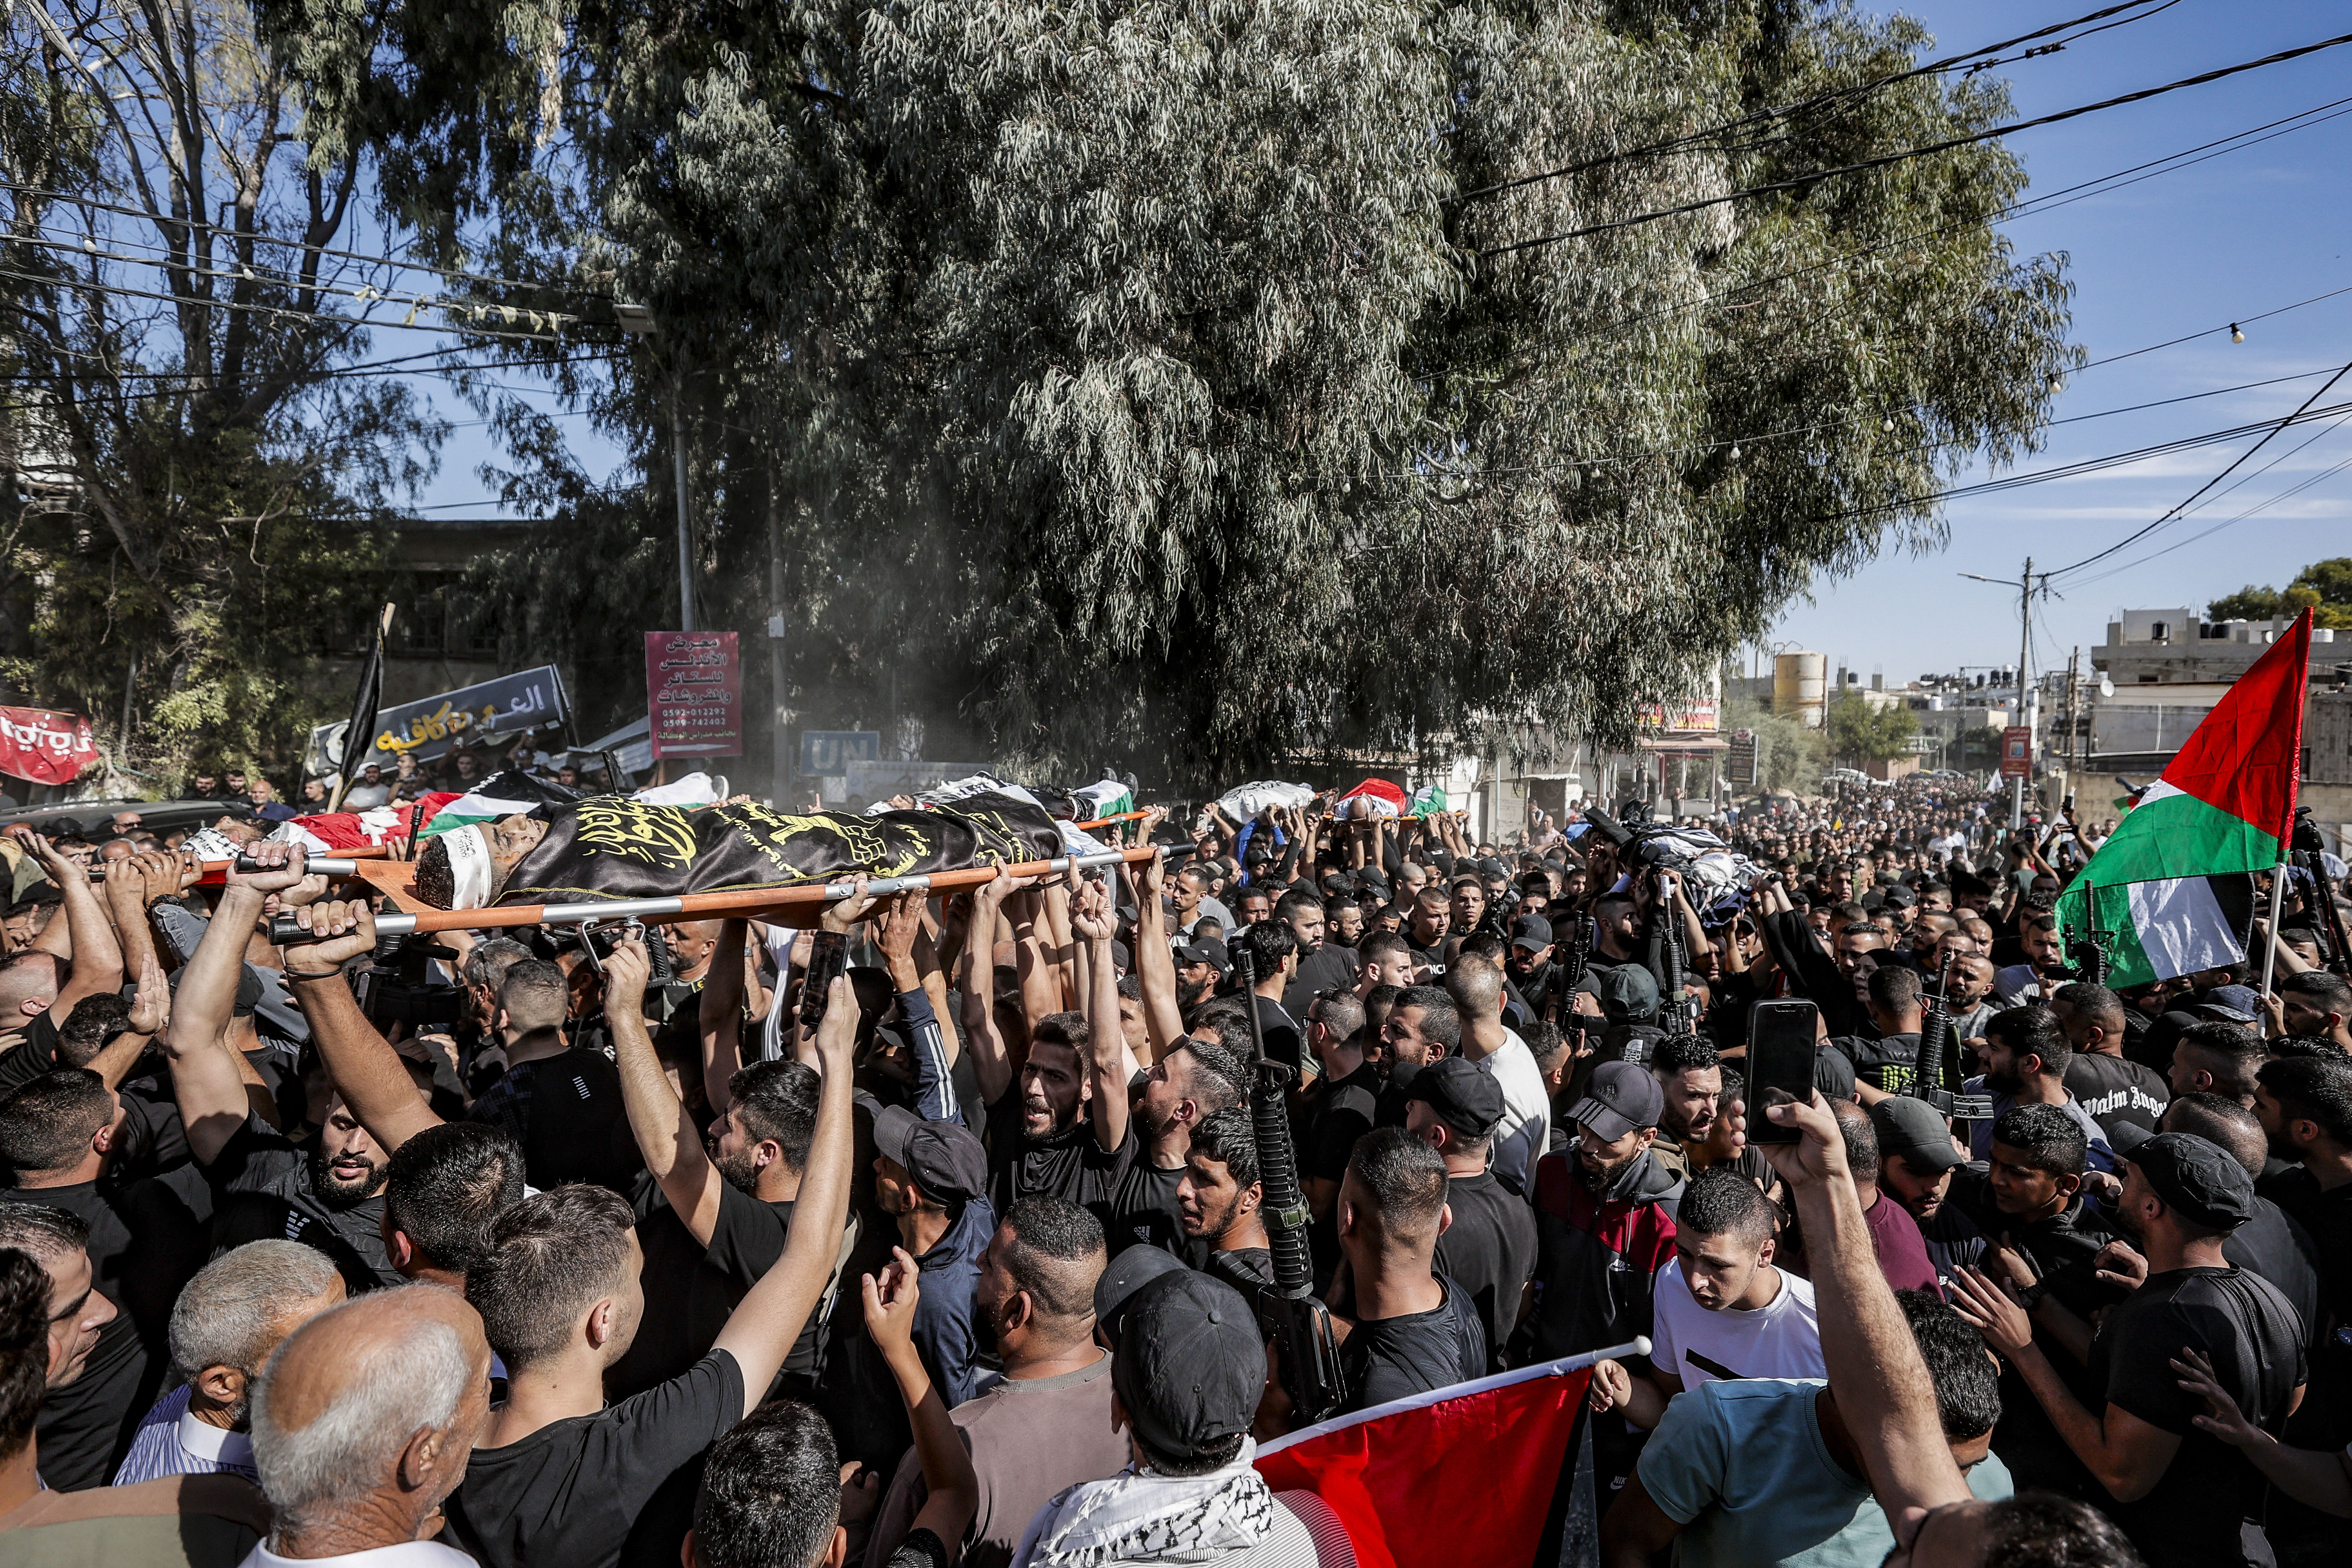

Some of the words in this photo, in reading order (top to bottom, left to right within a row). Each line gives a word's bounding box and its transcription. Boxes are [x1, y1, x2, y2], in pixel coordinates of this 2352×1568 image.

[666, 636, 719, 652] معرض
[665, 671, 724, 687] للستائر
[658, 688, 731, 704] والمفروشات
[662, 707, 725, 717] 0592-012292
[663, 718, 726, 727] 0599-742402
[811, 739, 867, 769] UN
[2082, 1089, 2128, 1117] Palm
[1134, 1227, 1150, 1244] adidas
[1614, 1476, 1627, 1485] NIK
